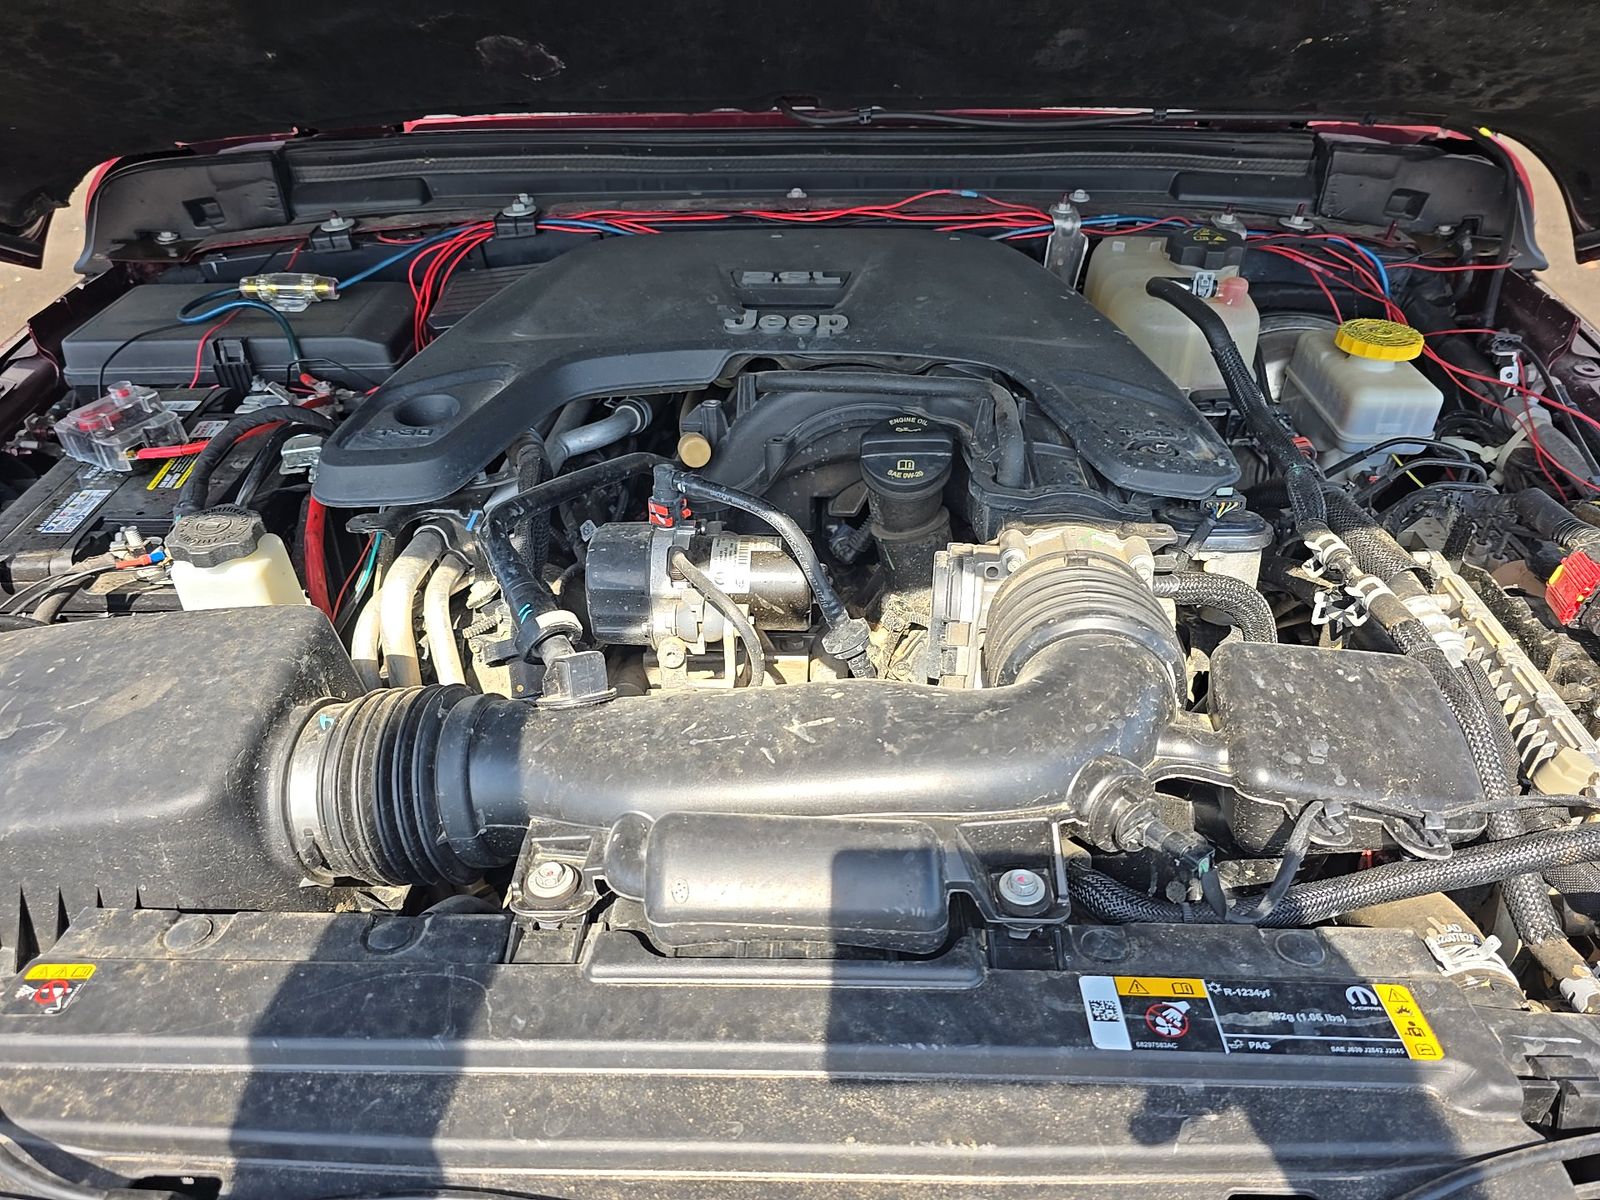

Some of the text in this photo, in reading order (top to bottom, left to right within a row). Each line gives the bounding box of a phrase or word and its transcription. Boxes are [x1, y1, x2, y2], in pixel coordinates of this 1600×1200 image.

[723, 308, 849, 338] Jeep
[888, 416, 929, 427] ENGINE OIL
[887, 469, 902, 478] SAE
[1223, 987, 1271, 999] R-1234yf
[1247, 1041, 1272, 1050] PAG
